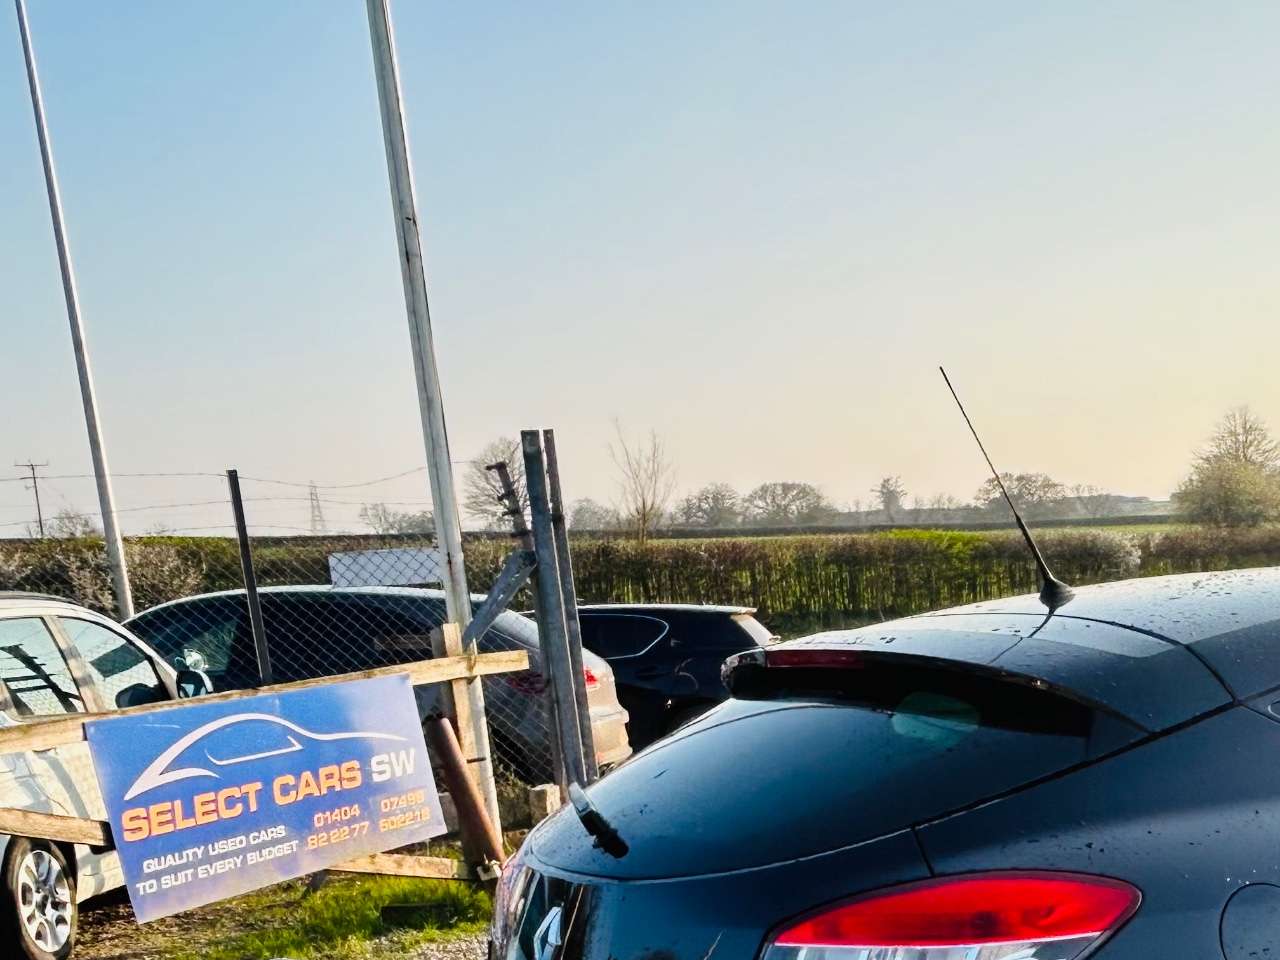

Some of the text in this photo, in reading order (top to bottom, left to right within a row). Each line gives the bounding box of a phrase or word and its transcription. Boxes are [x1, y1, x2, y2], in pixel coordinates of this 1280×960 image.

[121, 748, 417, 842] SELECT CARS SW
[313, 804, 361, 828] 01404
[135, 840, 300, 895] TO SUIT EVERY BUDGET
[142, 825, 287, 873] QUALITY USED CARS
